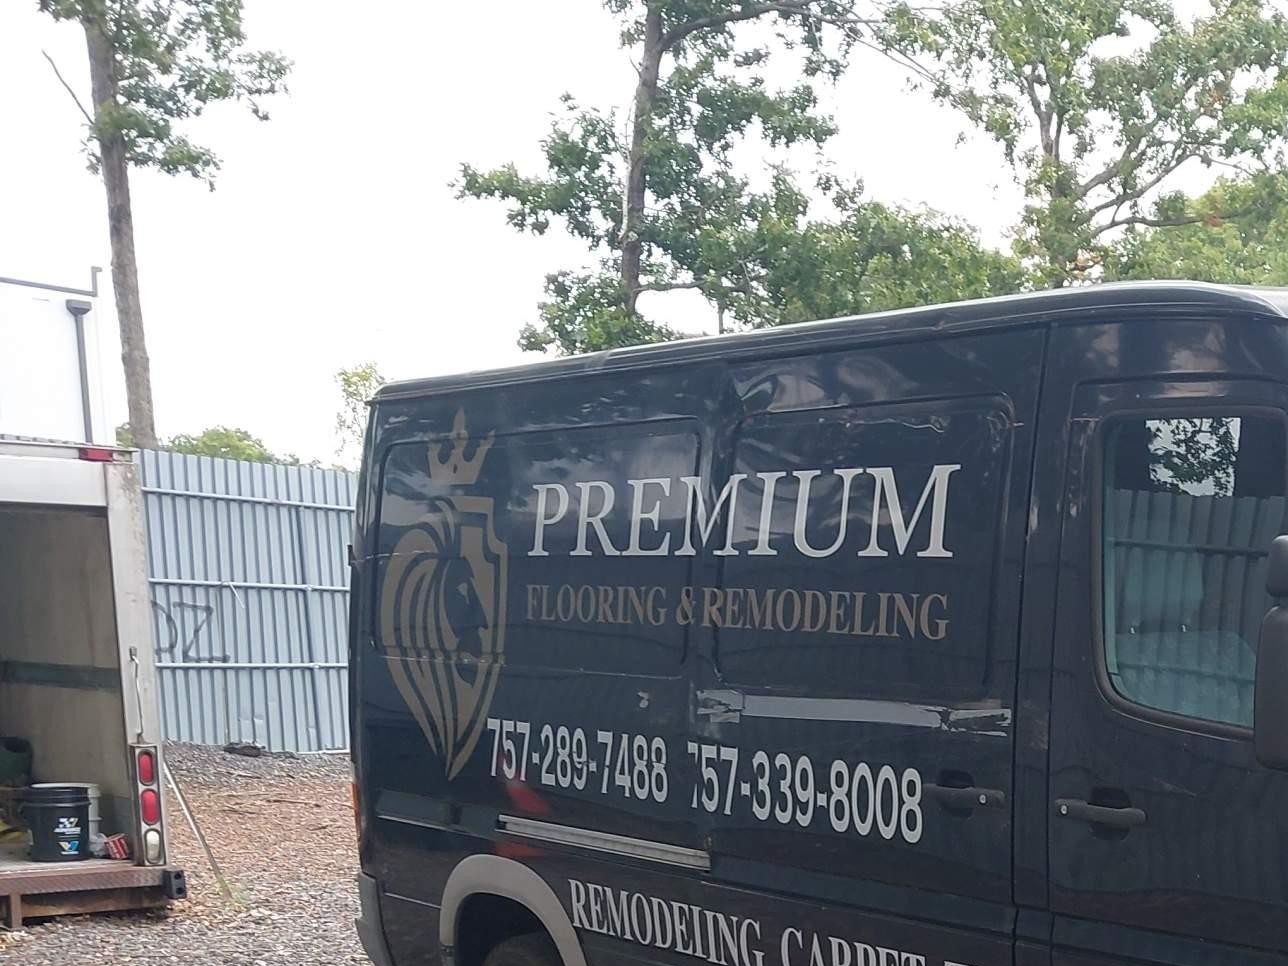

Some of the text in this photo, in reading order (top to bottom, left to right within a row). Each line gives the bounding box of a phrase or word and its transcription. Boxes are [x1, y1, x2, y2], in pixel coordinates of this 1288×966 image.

[526, 463, 961, 558] PREMIUM
[525, 584, 950, 640] FLOORING & REMODELING
[487, 718, 923, 844] 757-289-7488 757-339-8008
